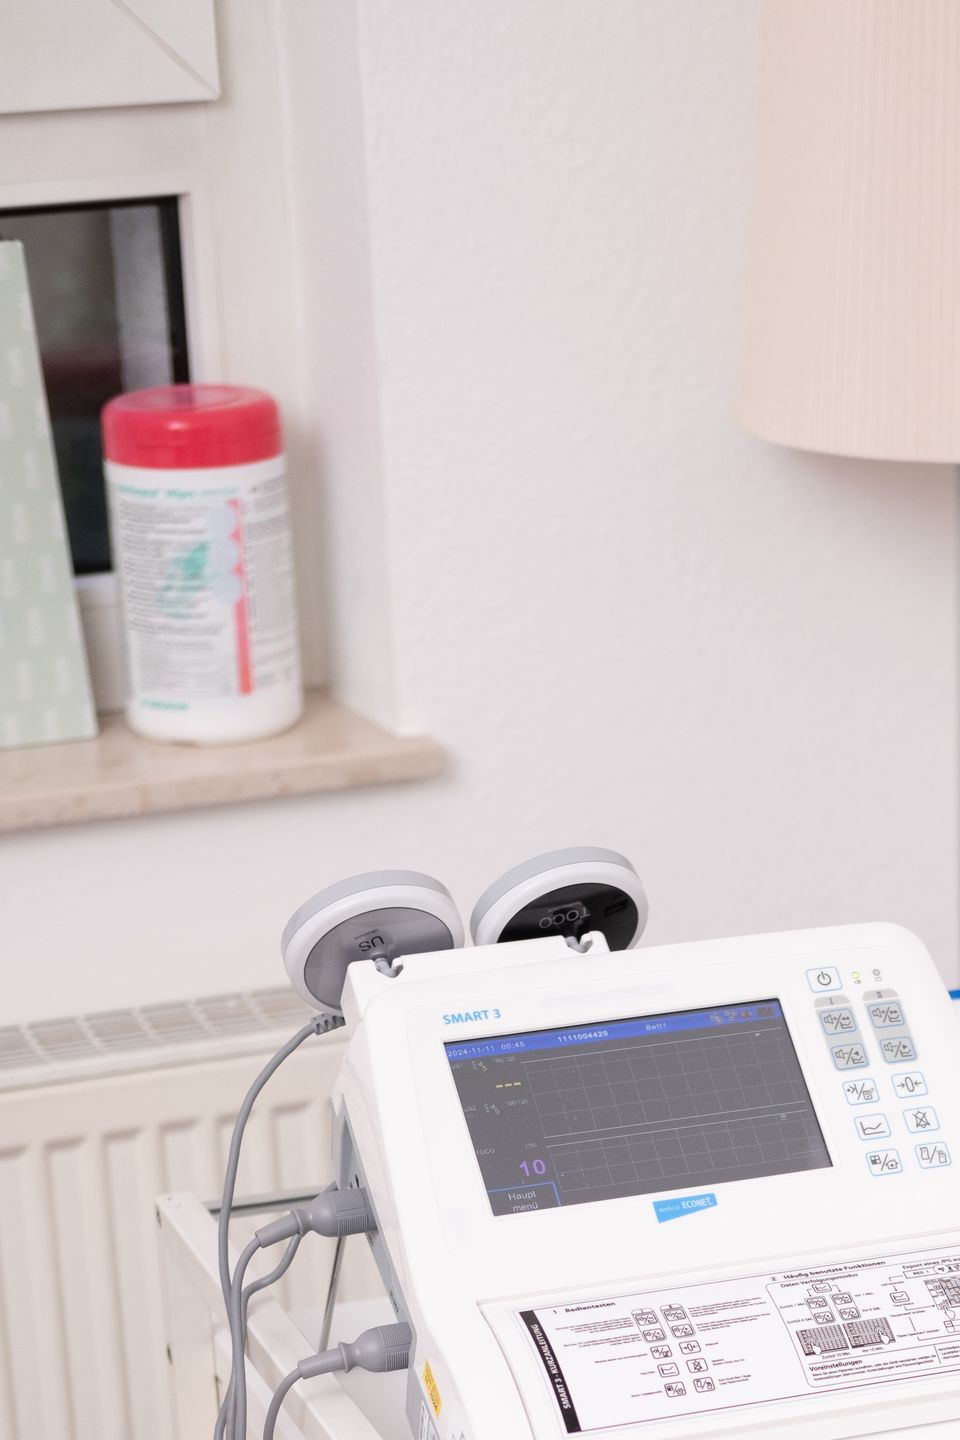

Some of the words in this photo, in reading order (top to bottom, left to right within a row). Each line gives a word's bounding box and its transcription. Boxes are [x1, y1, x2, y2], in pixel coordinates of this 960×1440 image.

[539, 906, 591, 928] TOCO
[359, 936, 384, 952] US
[443, 1010, 489, 1025] SMART
[492, 1008, 501, 1018] 3
[447, 1045, 494, 1056] 2024-11-11
[520, 1159, 546, 1176] 10
[508, 1190, 536, 1200] Haupt
[512, 1202, 538, 1212] menü
[844, 1261, 886, 1270] Funktionen
[565, 1302, 616, 1313] Bedientasten
[531, 1324, 558, 1374] KURZANLEITUNG
[809, 1360, 863, 1372] Voreinstellungen
[556, 1384, 572, 1409] SMART
